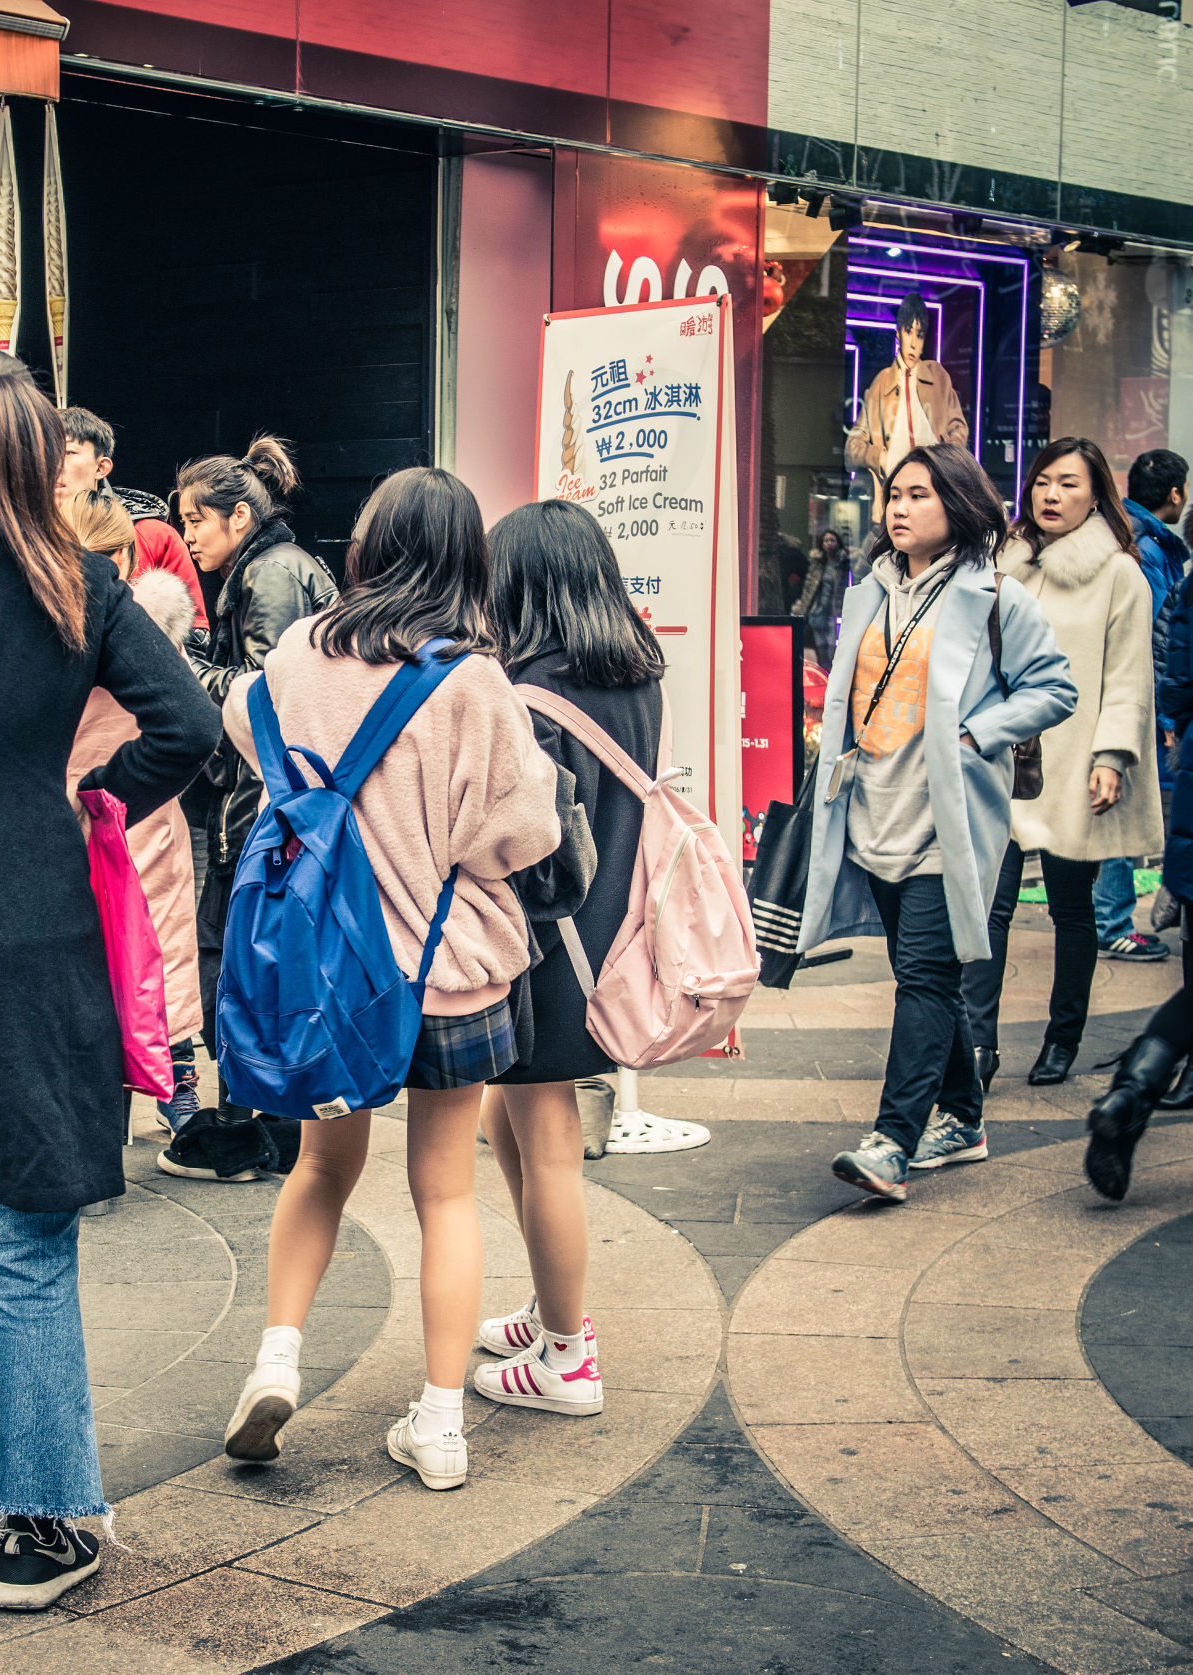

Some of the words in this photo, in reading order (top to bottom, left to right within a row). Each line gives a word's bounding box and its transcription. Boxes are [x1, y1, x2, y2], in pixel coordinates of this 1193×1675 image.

[590, 358, 629, 392] 元祖
[592, 396, 639, 425] 32cm
[644, 382, 702, 411] 冰淇淋
[558, 473, 582, 493] Ice
[599, 471, 617, 491] 32
[622, 464, 668, 486] Parfait
[597, 495, 624, 518] Soft
[628, 495, 648, 511] Ice
[652, 492, 704, 514] Cream
[617, 519, 658, 541] 2,000
[622, 575, 662, 595] 支付
